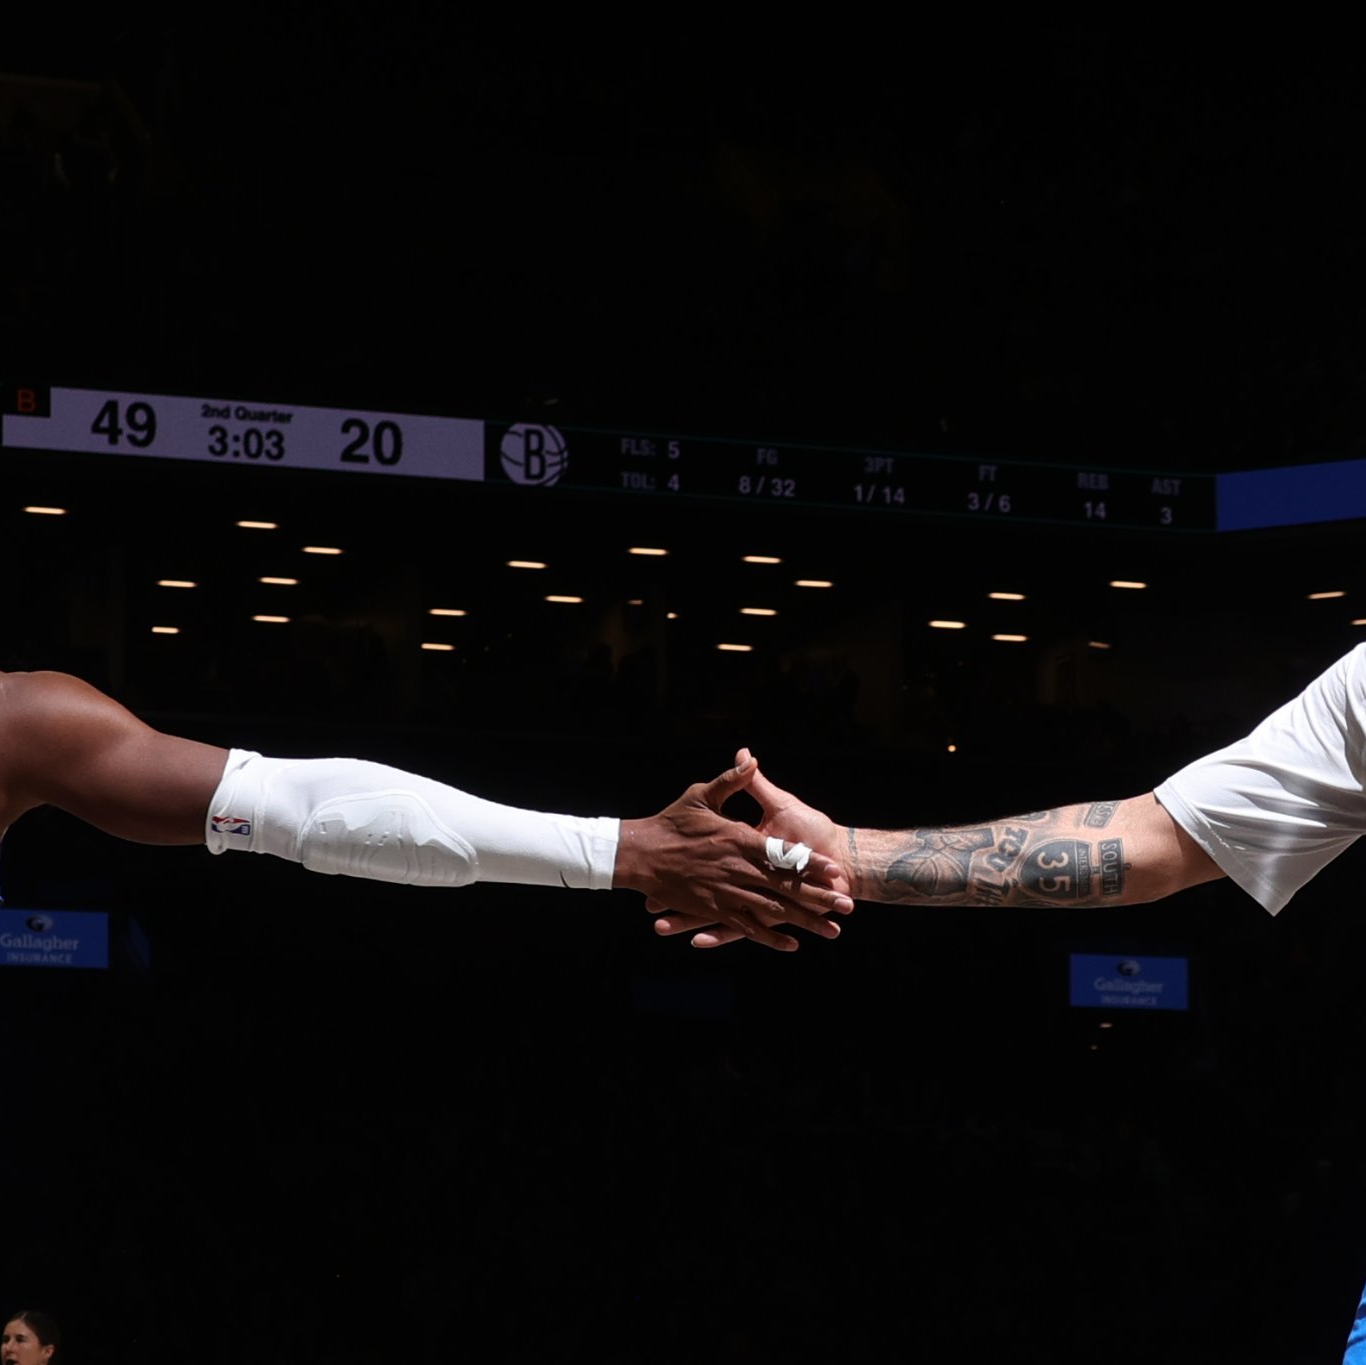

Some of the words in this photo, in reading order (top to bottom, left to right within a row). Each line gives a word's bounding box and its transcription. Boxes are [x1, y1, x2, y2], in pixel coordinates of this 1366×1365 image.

[16, 387, 39, 413] B
[91, 400, 156, 447] 49
[201, 403, 233, 421] 2nd
[235, 406, 293, 425] Quarter
[208, 426, 285, 461] 3:03
[340, 418, 403, 466] 20
[619, 436, 656, 457] FLS:
[666, 438, 682, 460] 5
[755, 447, 779, 467] FG
[863, 455, 895, 475] 3PT
[620, 470, 656, 491] TOL:
[666, 472, 681, 493] 4
[977, 464, 999, 482] FT
[1076, 471, 1110, 491] REB
[1149, 477, 1183, 497] AST
[1083, 500, 1108, 520] 14
[1159, 505, 1174, 526] 3
[1036, 851, 1071, 893] 35
[1100, 841, 1121, 895] SOUTH
